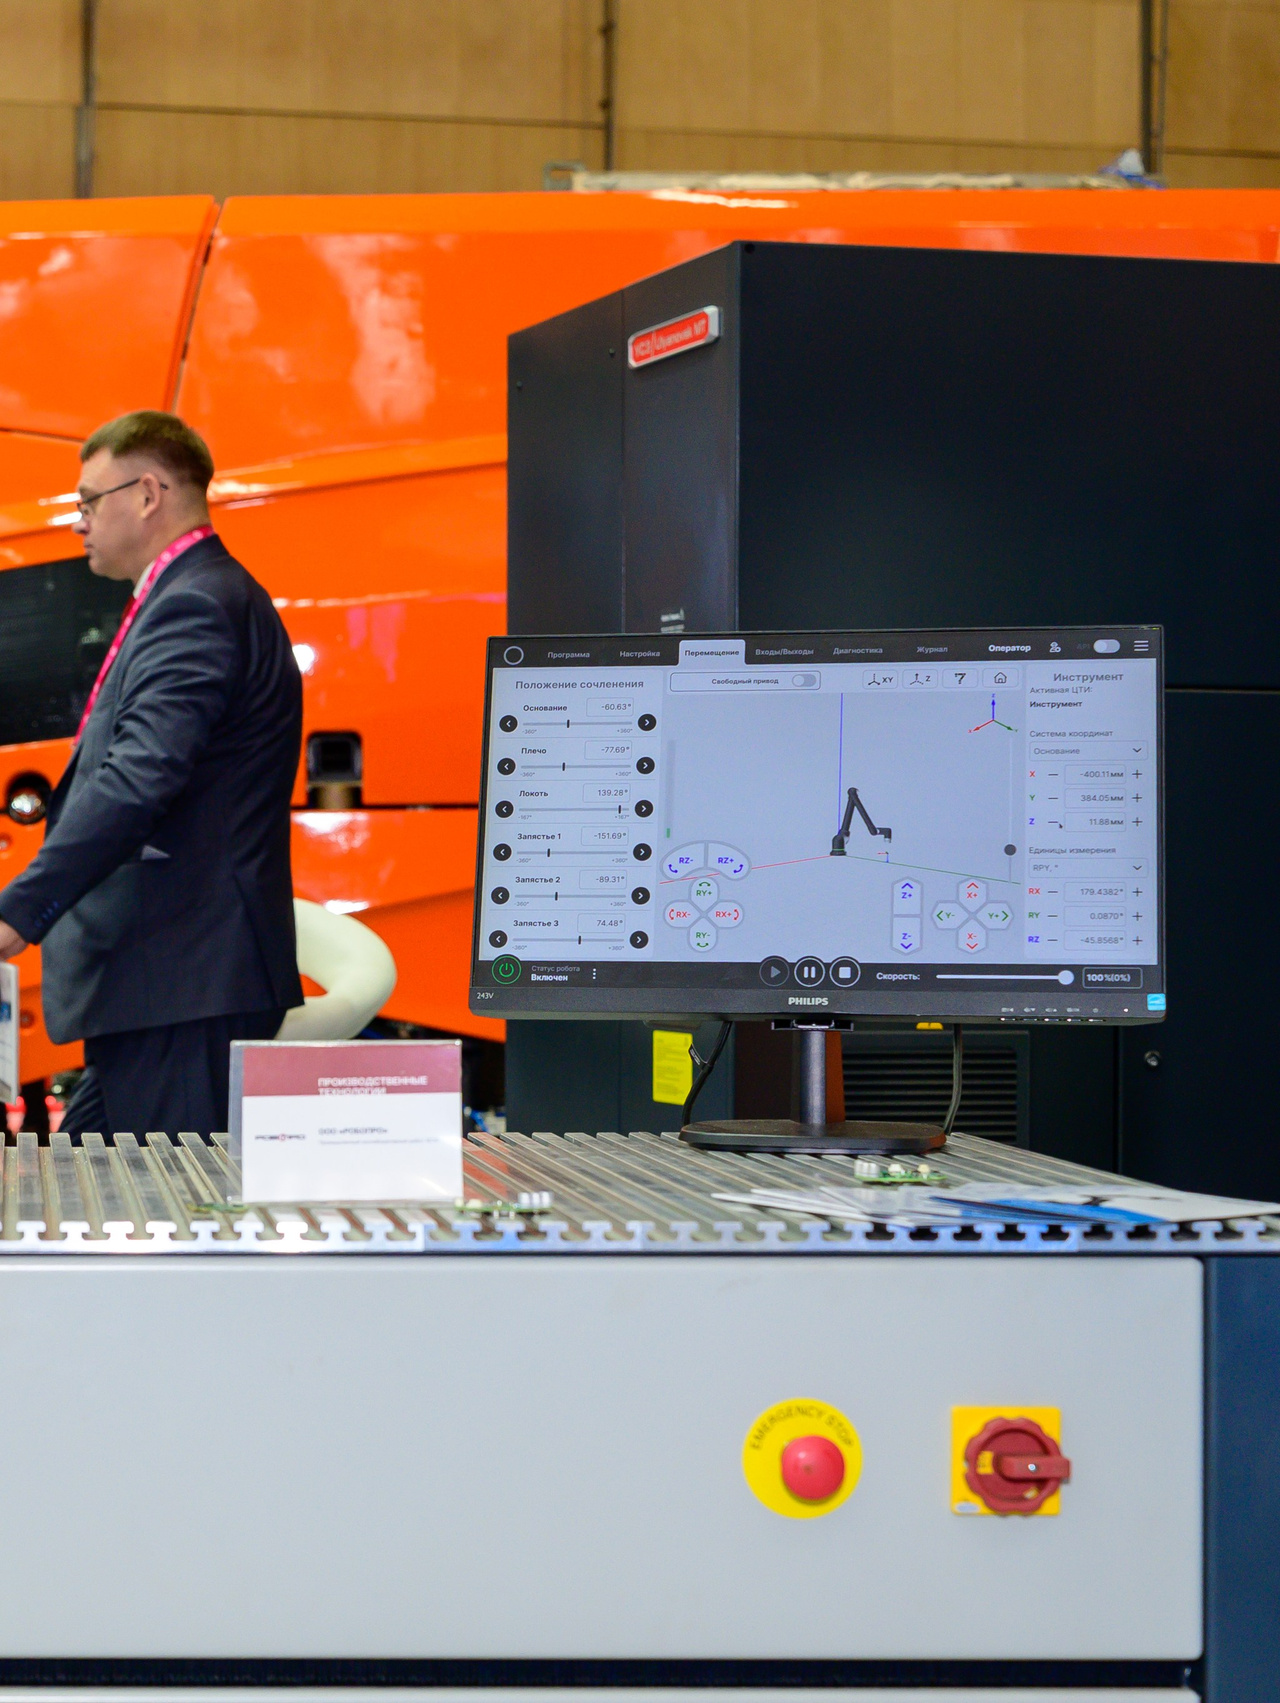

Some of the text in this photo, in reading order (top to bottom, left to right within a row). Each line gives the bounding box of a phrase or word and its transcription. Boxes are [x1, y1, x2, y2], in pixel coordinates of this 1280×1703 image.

[755, 647, 814, 656] Входы/Выходы
[833, 646, 883, 655] Диагностика
[917, 645, 948, 654] Журнал
[988, 644, 1031, 653] Оператор
[547, 651, 590, 660] Программа
[620, 650, 660, 658] Настройка
[684, 649, 740, 657] Перемещение
[712, 678, 752, 686] Свободный
[882, 676, 893, 685] XY
[1053, 673, 1124, 683] Инструмент
[515, 680, 644, 690] Положение сочленения
[1072, 686, 1093, 694] ЦТИ:
[523, 704, 568, 712] Основание
[1029, 700, 1083, 709] Инструмент
[1069, 730, 1113, 739] координат
[1034, 747, 1080, 755] Основание
[1028, 847, 1067, 855] Единицы
[718, 857, 735, 865] RZ+
[988, 912, 1000, 920] Y+
[902, 932, 912, 940] Z-
[967, 932, 978, 940] X-
[556, 965, 581, 974] робота
[531, 974, 568, 982] Включен
[876, 972, 920, 982] Скорость:
[477, 992, 494, 1000] 243V
[788, 997, 829, 1005] PHILIPS
[317, 1075, 428, 1087] ПРОИЗВОДСТВЕННЫЕ
[318, 1087, 386, 1095] ТЕХНОЛОГИИ
[749, 1405, 853, 1450] EMERGENCY STOP
